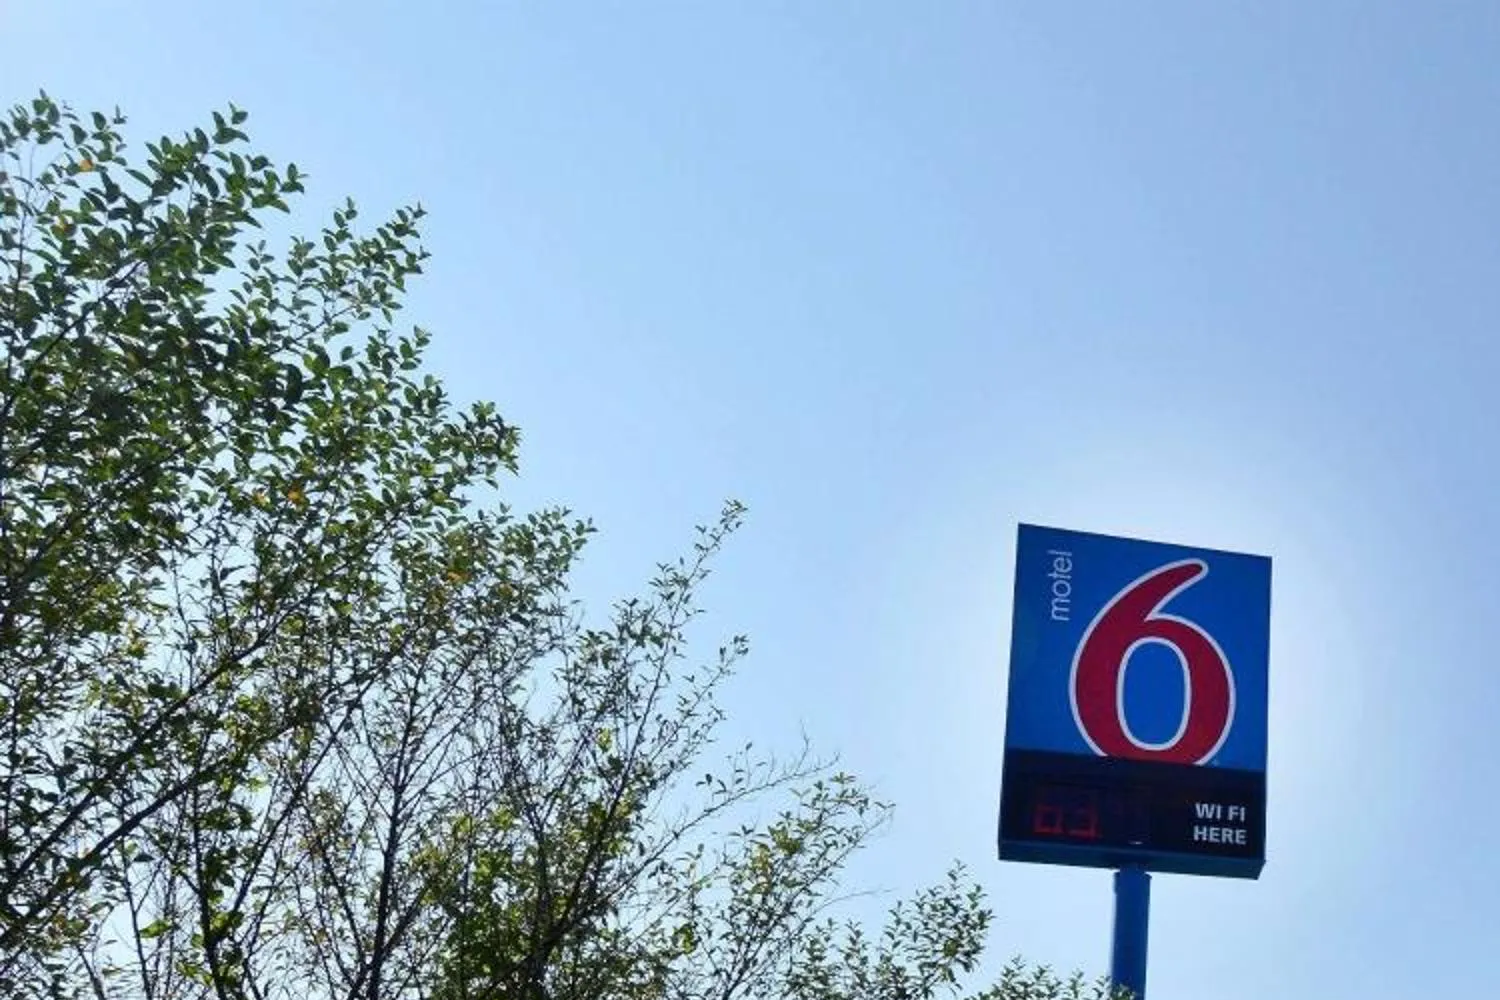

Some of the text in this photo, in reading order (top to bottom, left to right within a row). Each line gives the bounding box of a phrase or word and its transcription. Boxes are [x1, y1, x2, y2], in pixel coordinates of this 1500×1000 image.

[1047, 549, 1072, 621] motel
[1069, 558, 1236, 765] 6
[1193, 825, 1247, 845] HERE
[1195, 802, 1246, 823] WI FI
